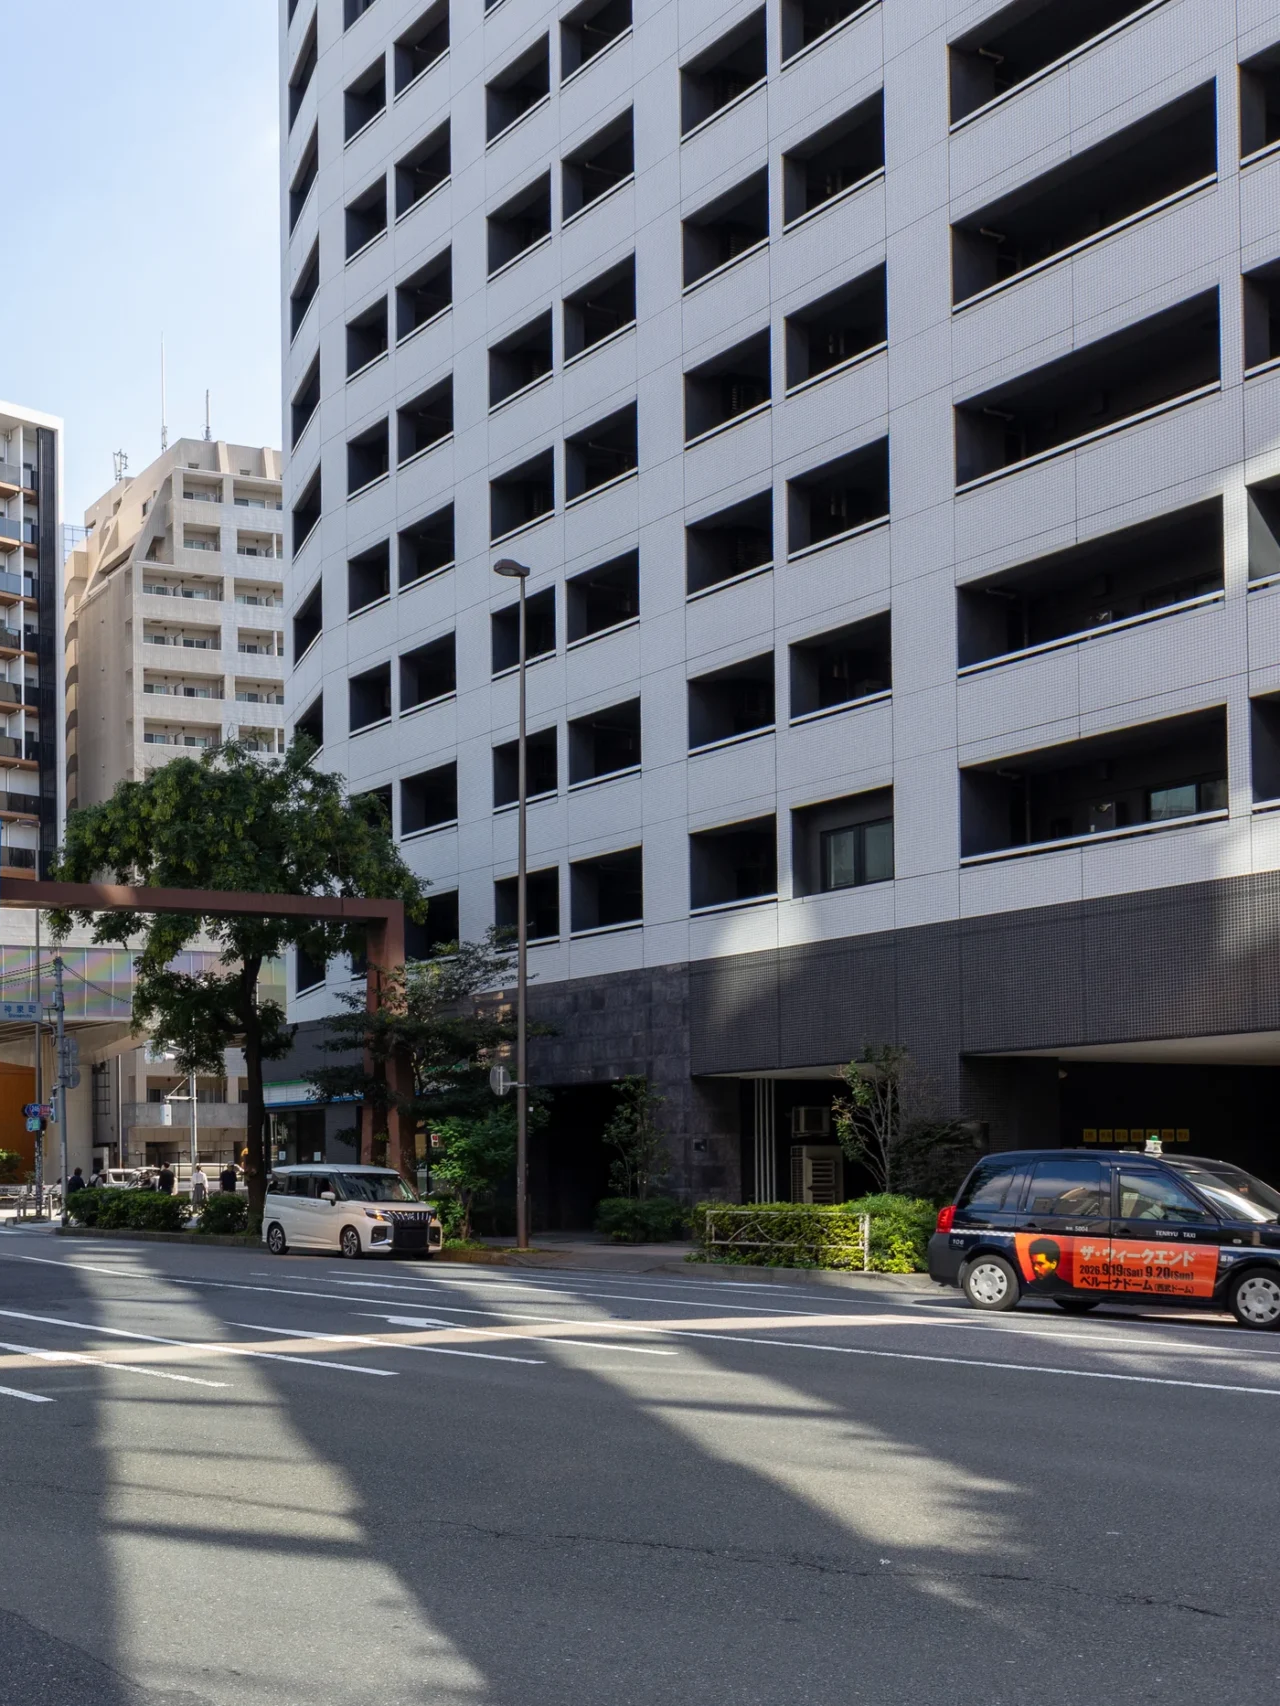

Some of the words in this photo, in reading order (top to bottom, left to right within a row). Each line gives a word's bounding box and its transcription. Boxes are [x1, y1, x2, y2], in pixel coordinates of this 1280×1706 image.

[1080, 1245, 1196, 1267] ザ・ウィークエンド
